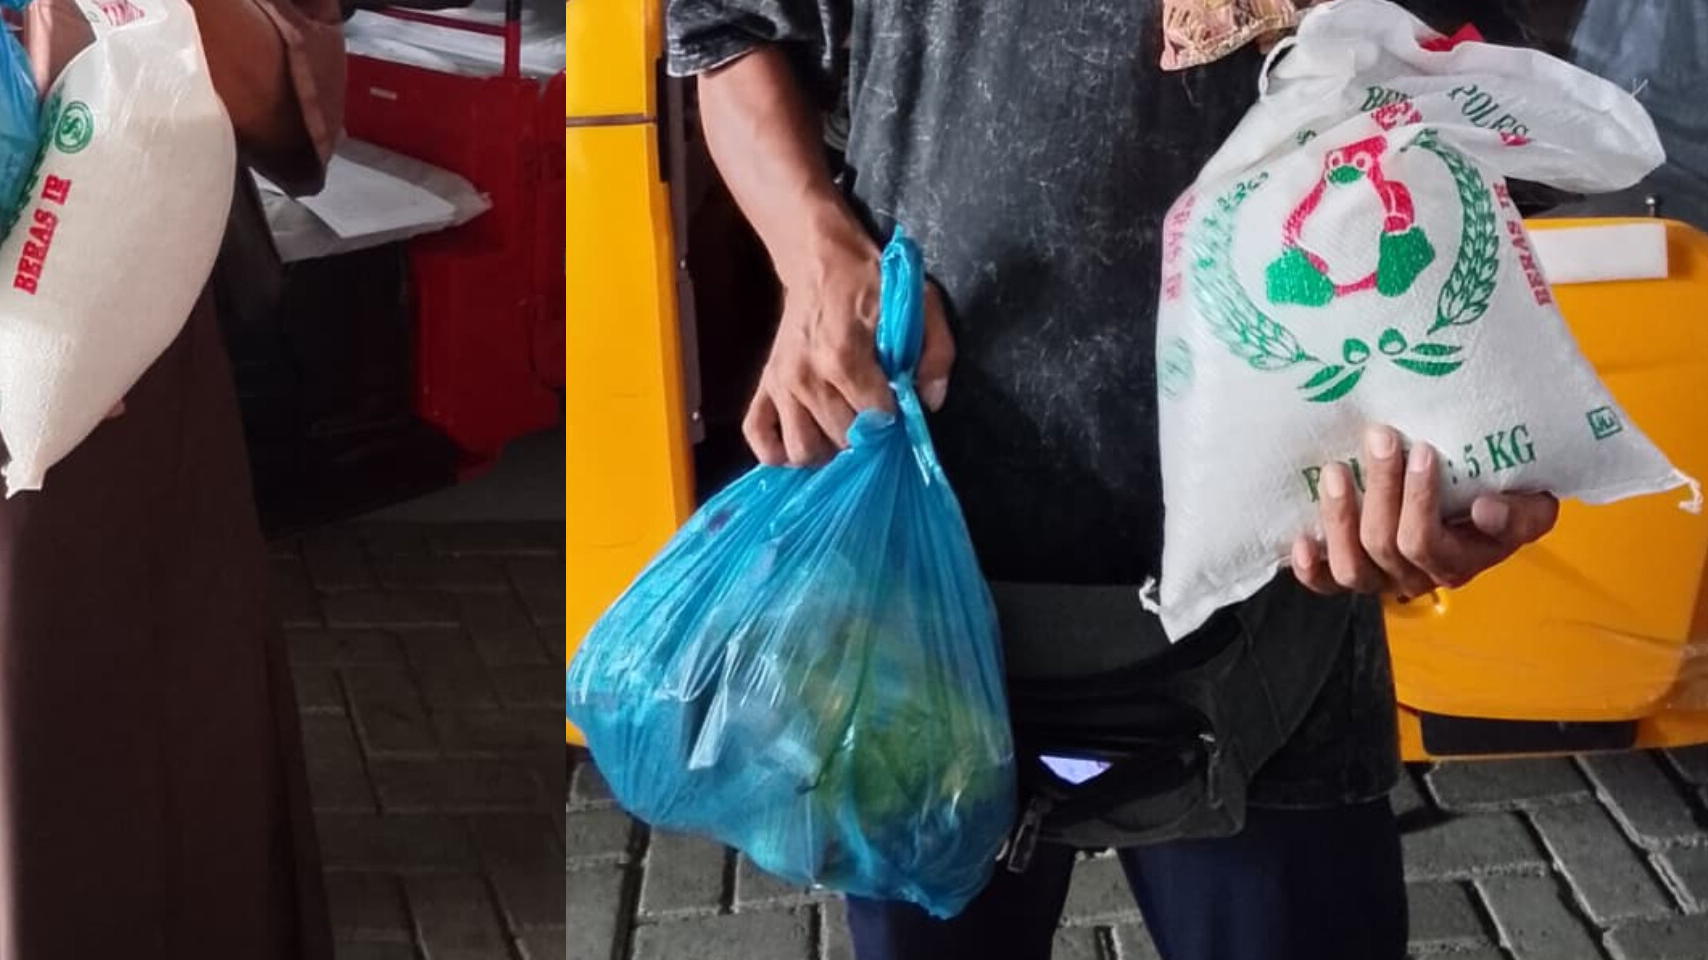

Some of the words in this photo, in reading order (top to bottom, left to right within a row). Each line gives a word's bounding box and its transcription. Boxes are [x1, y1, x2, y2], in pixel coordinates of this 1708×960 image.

[13, 207, 59, 296] BERAS
[40, 173, 73, 206] IR
[1506, 219, 1553, 307] BERAS
[1462, 443, 1481, 479] 5
[1484, 424, 1537, 472] KG
